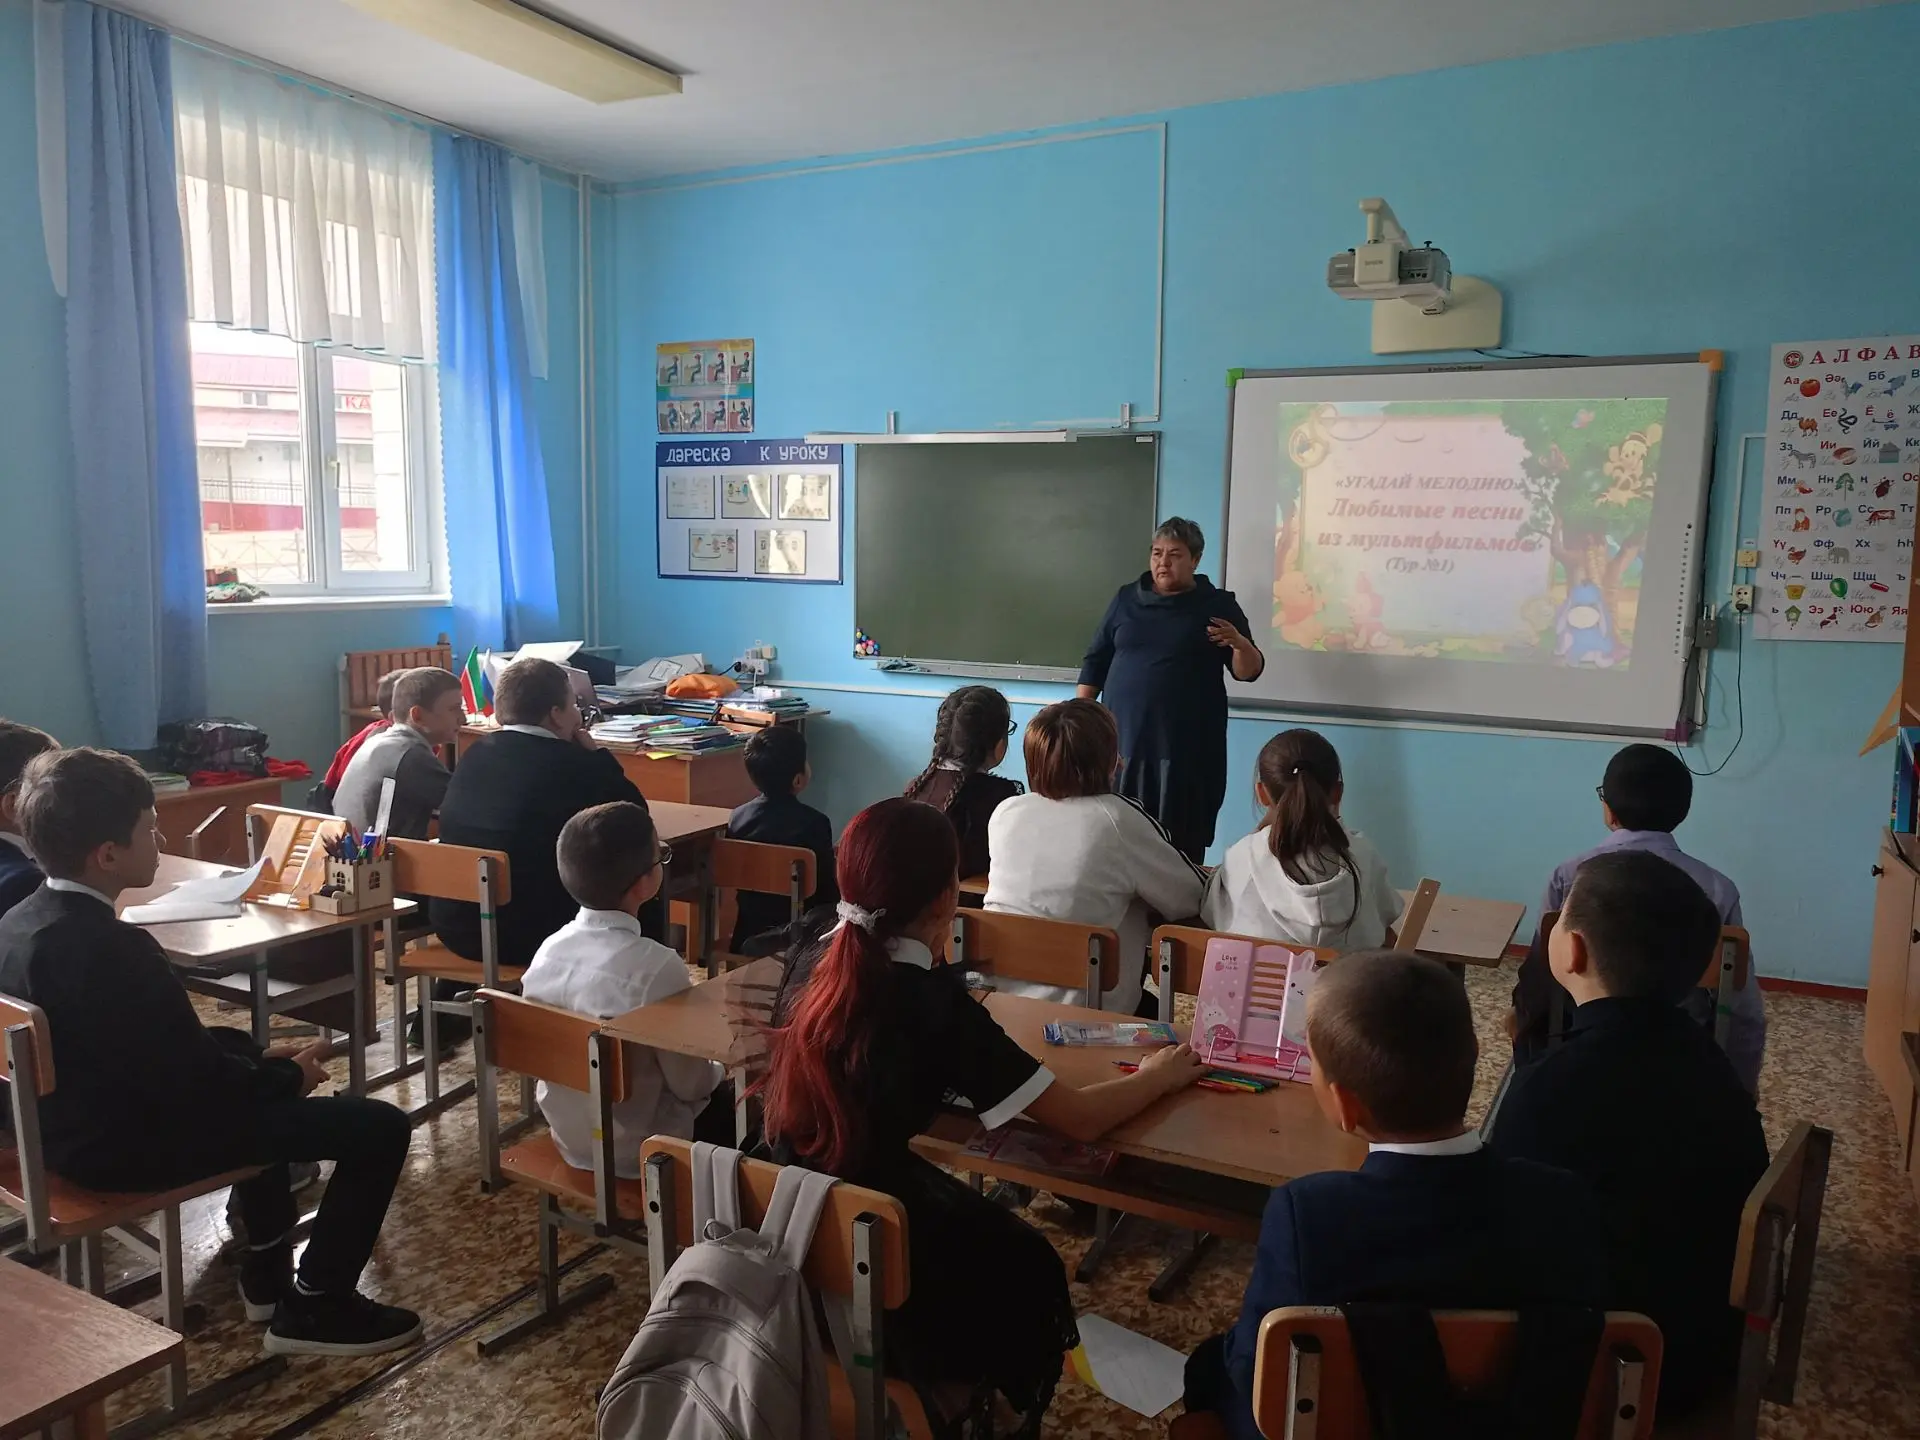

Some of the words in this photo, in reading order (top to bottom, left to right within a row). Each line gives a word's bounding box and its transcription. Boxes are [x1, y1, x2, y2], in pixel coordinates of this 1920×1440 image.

[1783, 376, 1800, 385] Аа
[1868, 371, 1886, 381] Бб
[1781, 411, 1798, 421] Дд
[1823, 409, 1838, 418] Ее
[1780, 442, 1793, 451] Зз
[1820, 441, 1837, 449] Ии
[1863, 438, 1880, 448] Йй
[1335, 472, 1412, 490] «УГАДАЙ
[1777, 476, 1796, 485] Мм
[1818, 475, 1834, 483] Нн
[1328, 498, 1446, 518] Любимые
[1452, 505, 1524, 521] песни
[1775, 506, 1791, 514] Пп
[1816, 506, 1831, 516] Рр
[1858, 504, 1874, 513] Сс
[1900, 503, 1915, 512] Тт
[1317, 531, 1342, 546] из
[1813, 540, 1835, 549] Фф
[1856, 539, 1871, 548] Хх
[1385, 557, 1419, 573] (Тур
[1421, 558, 1455, 574] №1)
[1771, 571, 1786, 580] Чч
[1811, 571, 1833, 580] Шш
[1808, 605, 1824, 614] Ээ
[1850, 605, 1874, 614] Юю
